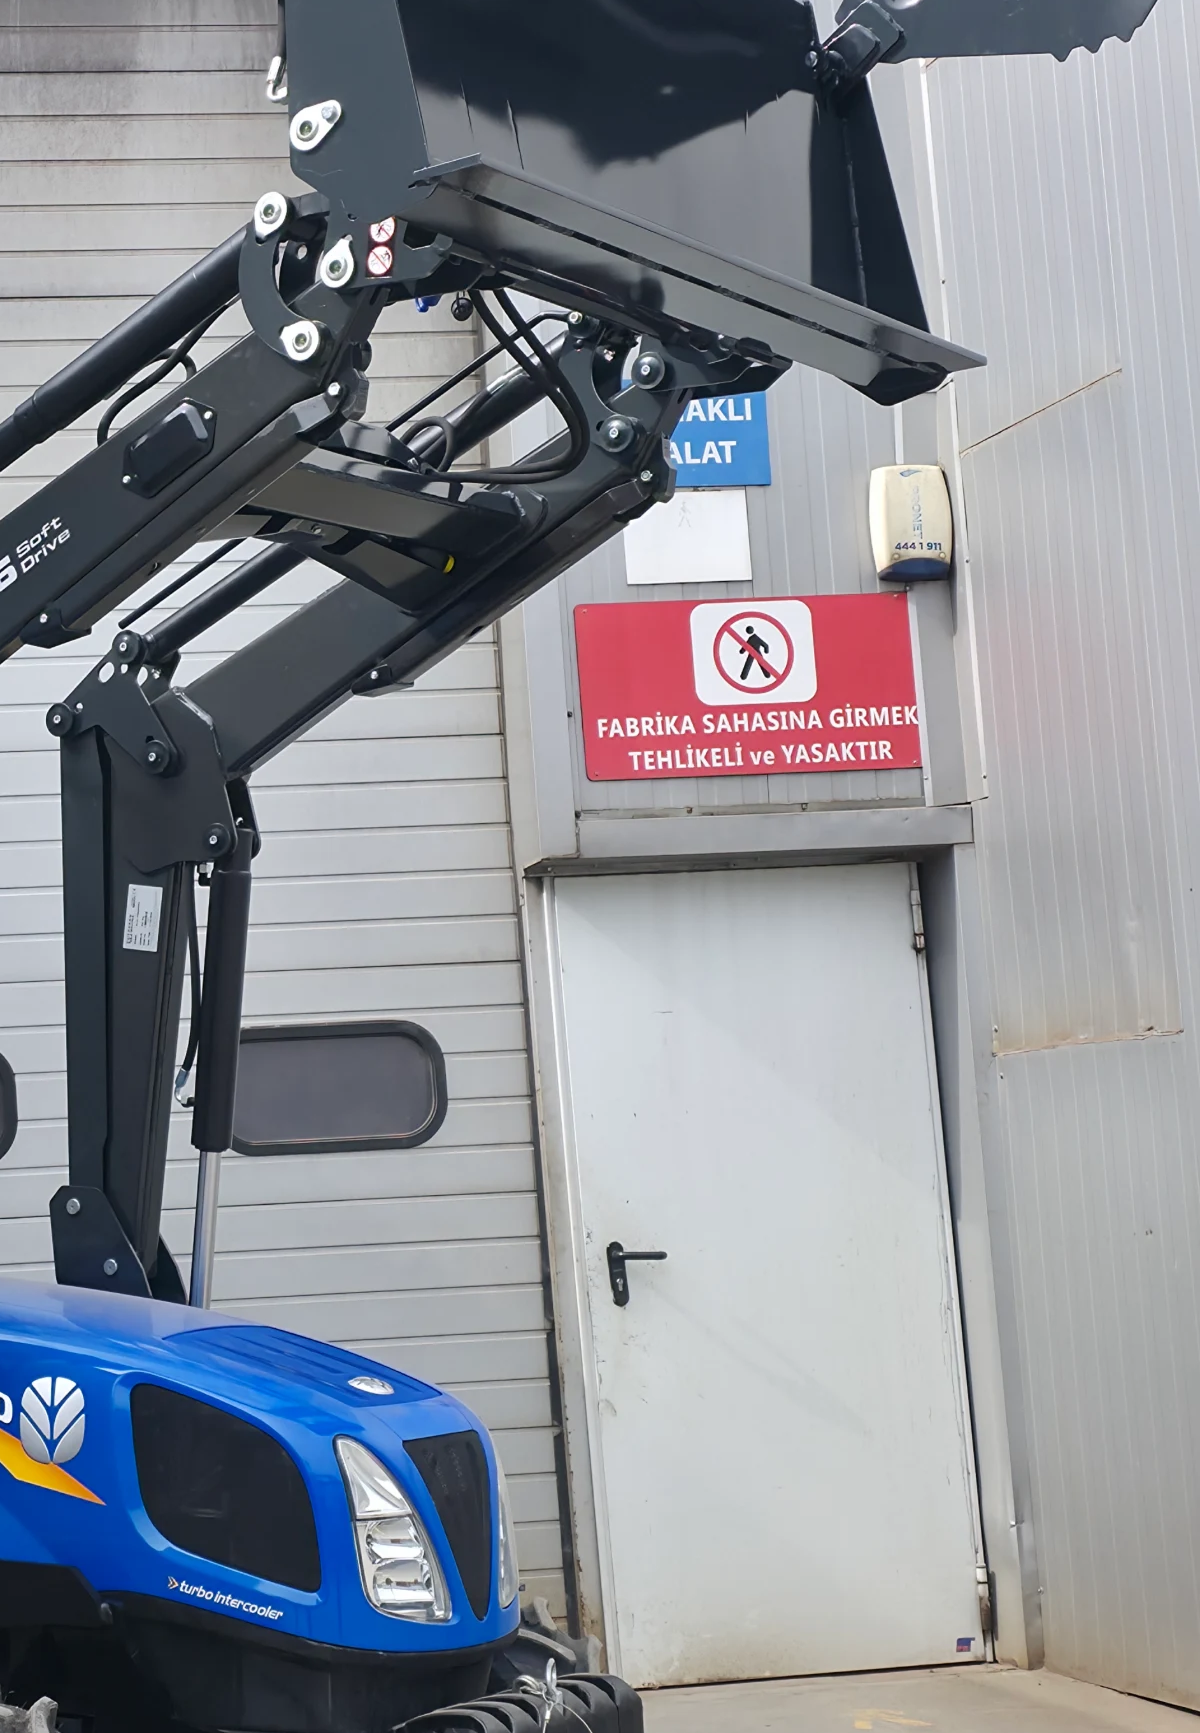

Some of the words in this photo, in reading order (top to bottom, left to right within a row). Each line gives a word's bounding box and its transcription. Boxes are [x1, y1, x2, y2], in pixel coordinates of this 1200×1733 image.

[680, 398, 752, 422] AKLI
[16, 516, 63, 558] Soft
[20, 528, 71, 574] Drive
[894, 542, 917, 550] 444
[927, 542, 942, 551] 911
[597, 711, 696, 738] FABRİKA
[702, 709, 823, 734] SAHASINA
[829, 703, 919, 727] GİRMEK
[628, 741, 744, 771] TEHLİKELİ
[750, 749, 775, 765] ve
[781, 740, 894, 764] YASAKTIR
[179, 1580, 214, 1601] turbo
[213, 1590, 284, 1620] intercooler
